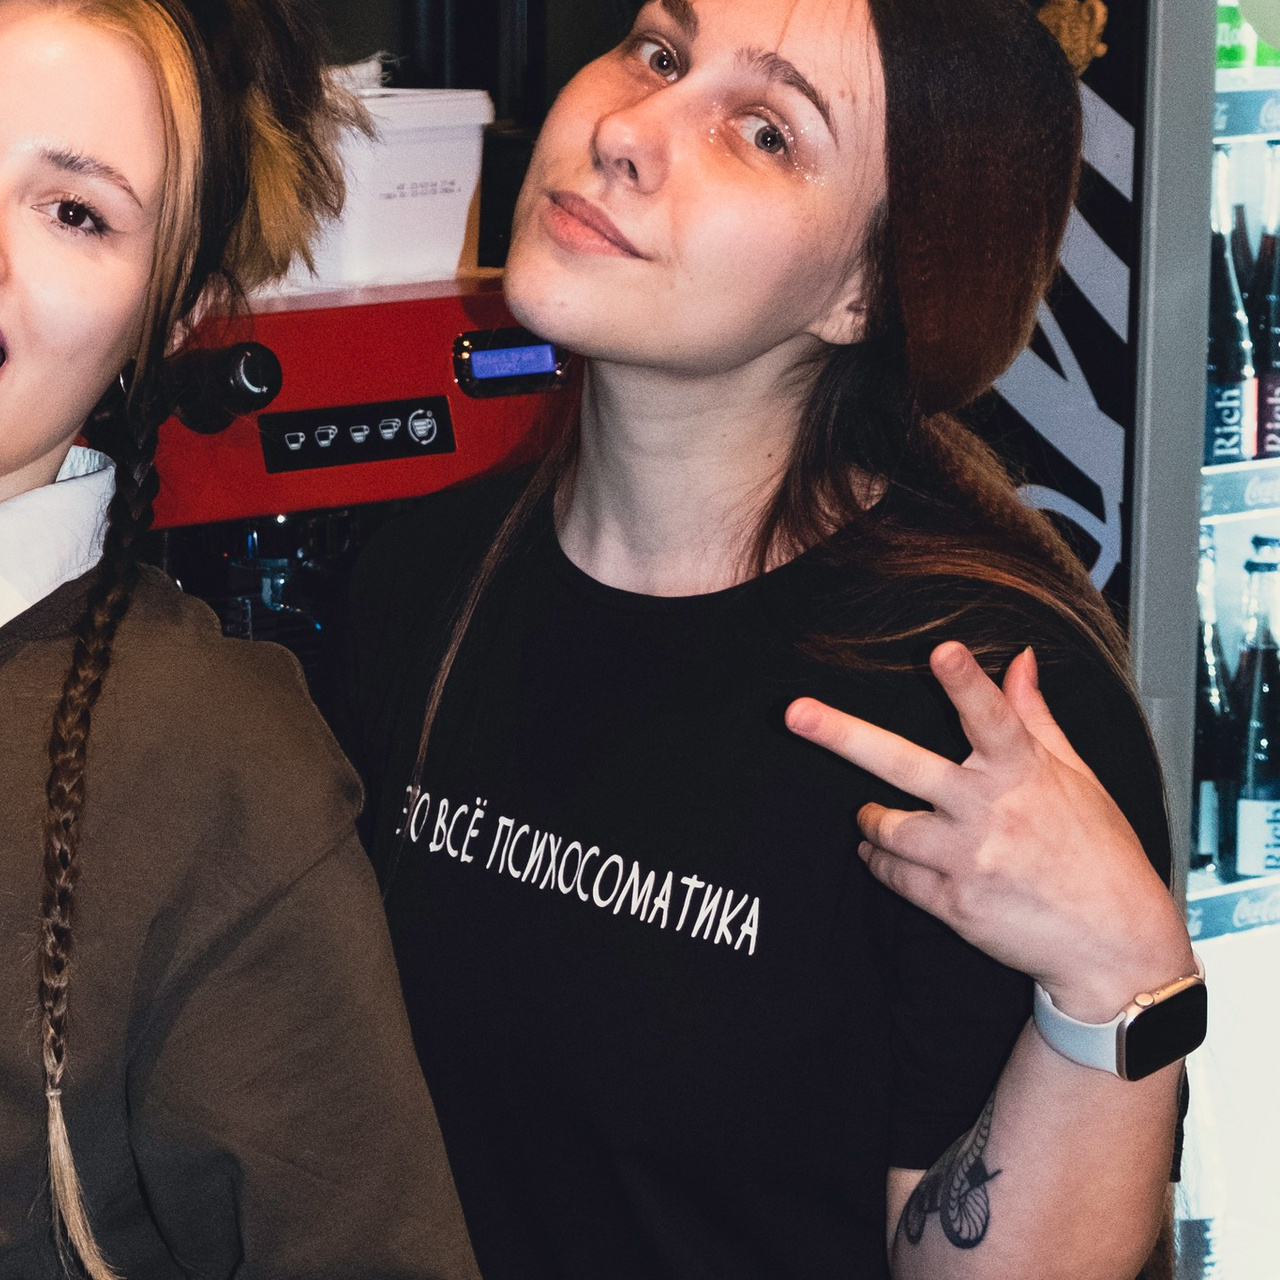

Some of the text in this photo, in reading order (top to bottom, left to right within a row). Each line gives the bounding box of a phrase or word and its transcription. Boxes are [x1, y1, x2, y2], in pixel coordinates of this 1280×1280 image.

[1213, 388, 1241, 457] Rich
[429, 797, 487, 864] ВСЁ
[486, 816, 760, 956] ПСИХОСОМАТИКА
